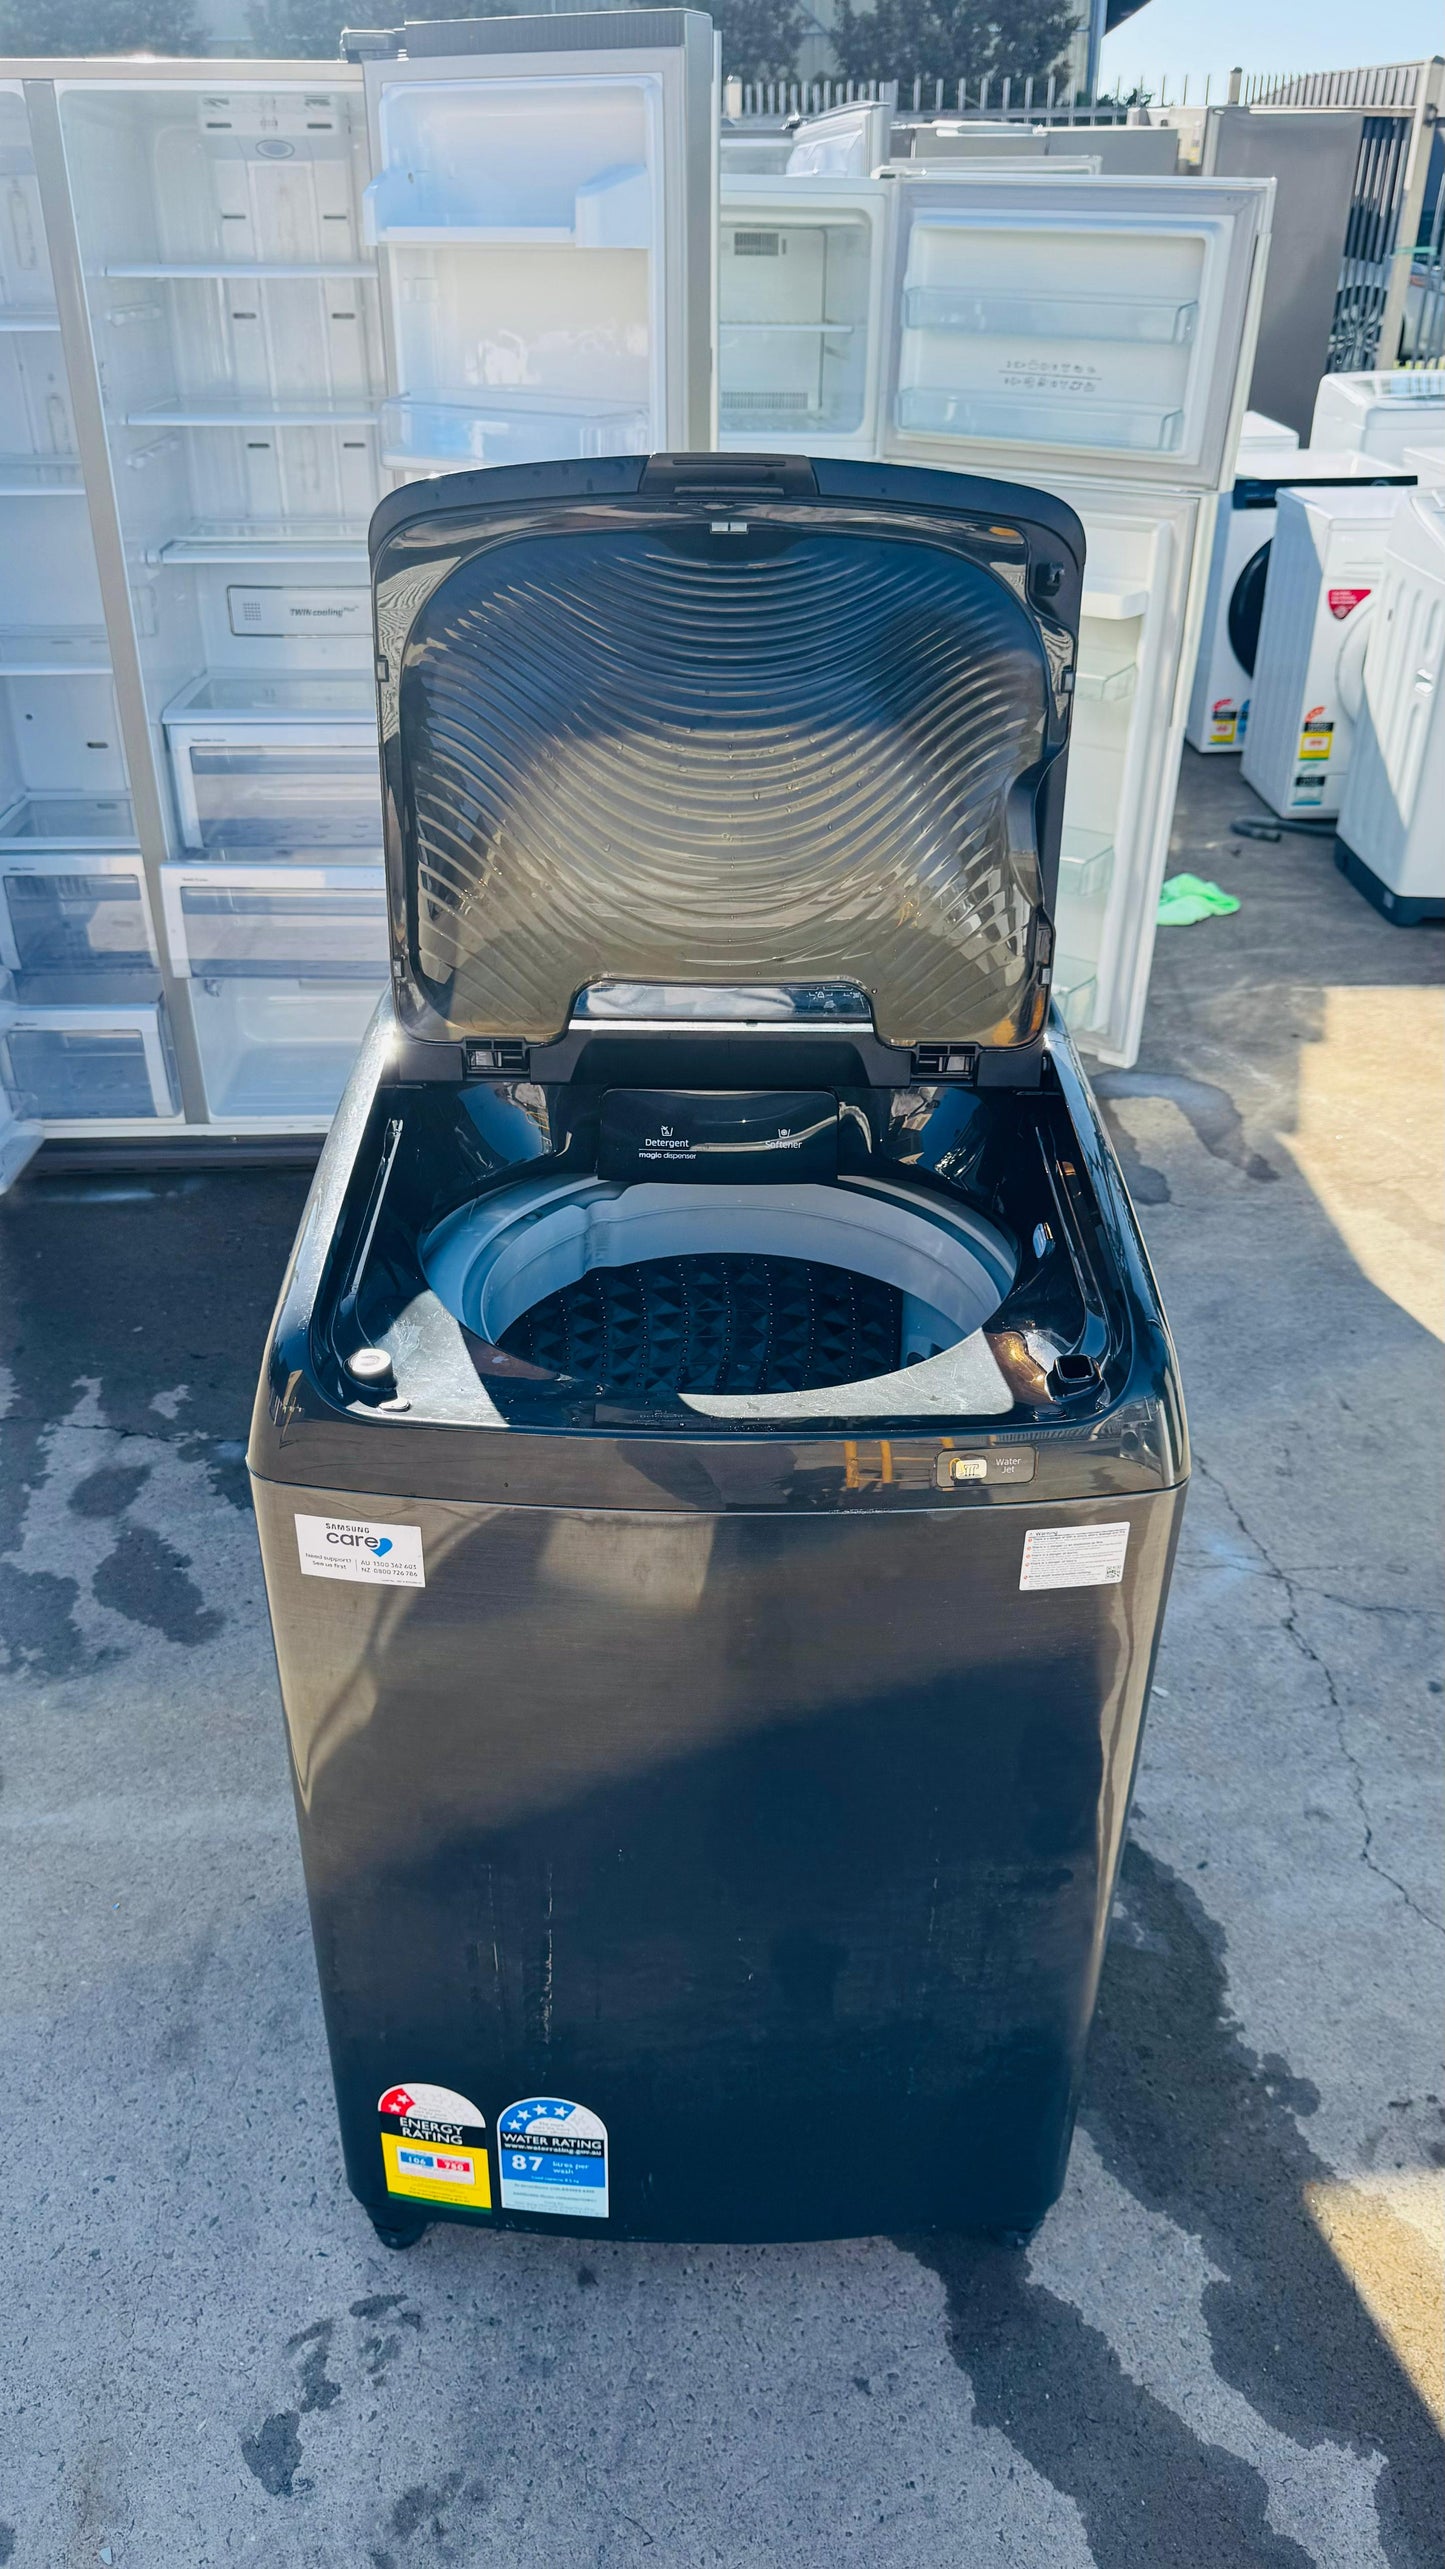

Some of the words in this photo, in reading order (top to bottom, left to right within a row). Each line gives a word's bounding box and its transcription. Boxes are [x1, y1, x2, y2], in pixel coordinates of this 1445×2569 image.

[645, 1138, 689, 1148] Detergent
[765, 1140, 803, 1149] Softener
[638, 1152, 662, 1160] magic
[663, 1152, 697, 1160] dispenser
[995, 1457, 1022, 1466] Water
[1001, 1465, 1015, 1474] Jet
[325, 1522, 370, 1534] SAMSUNG
[326, 1532, 379, 1548] care
[400, 2117, 464, 2135] ENERGY
[402, 2127, 463, 2145] RATING
[502, 2132, 549, 2146] WATER
[551, 2138, 602, 2150] RATING
[504, 2143, 602, 2156] www.waterrating.gov.au
[511, 2154, 543, 2172] 87
[575, 2163, 589, 2171] per
